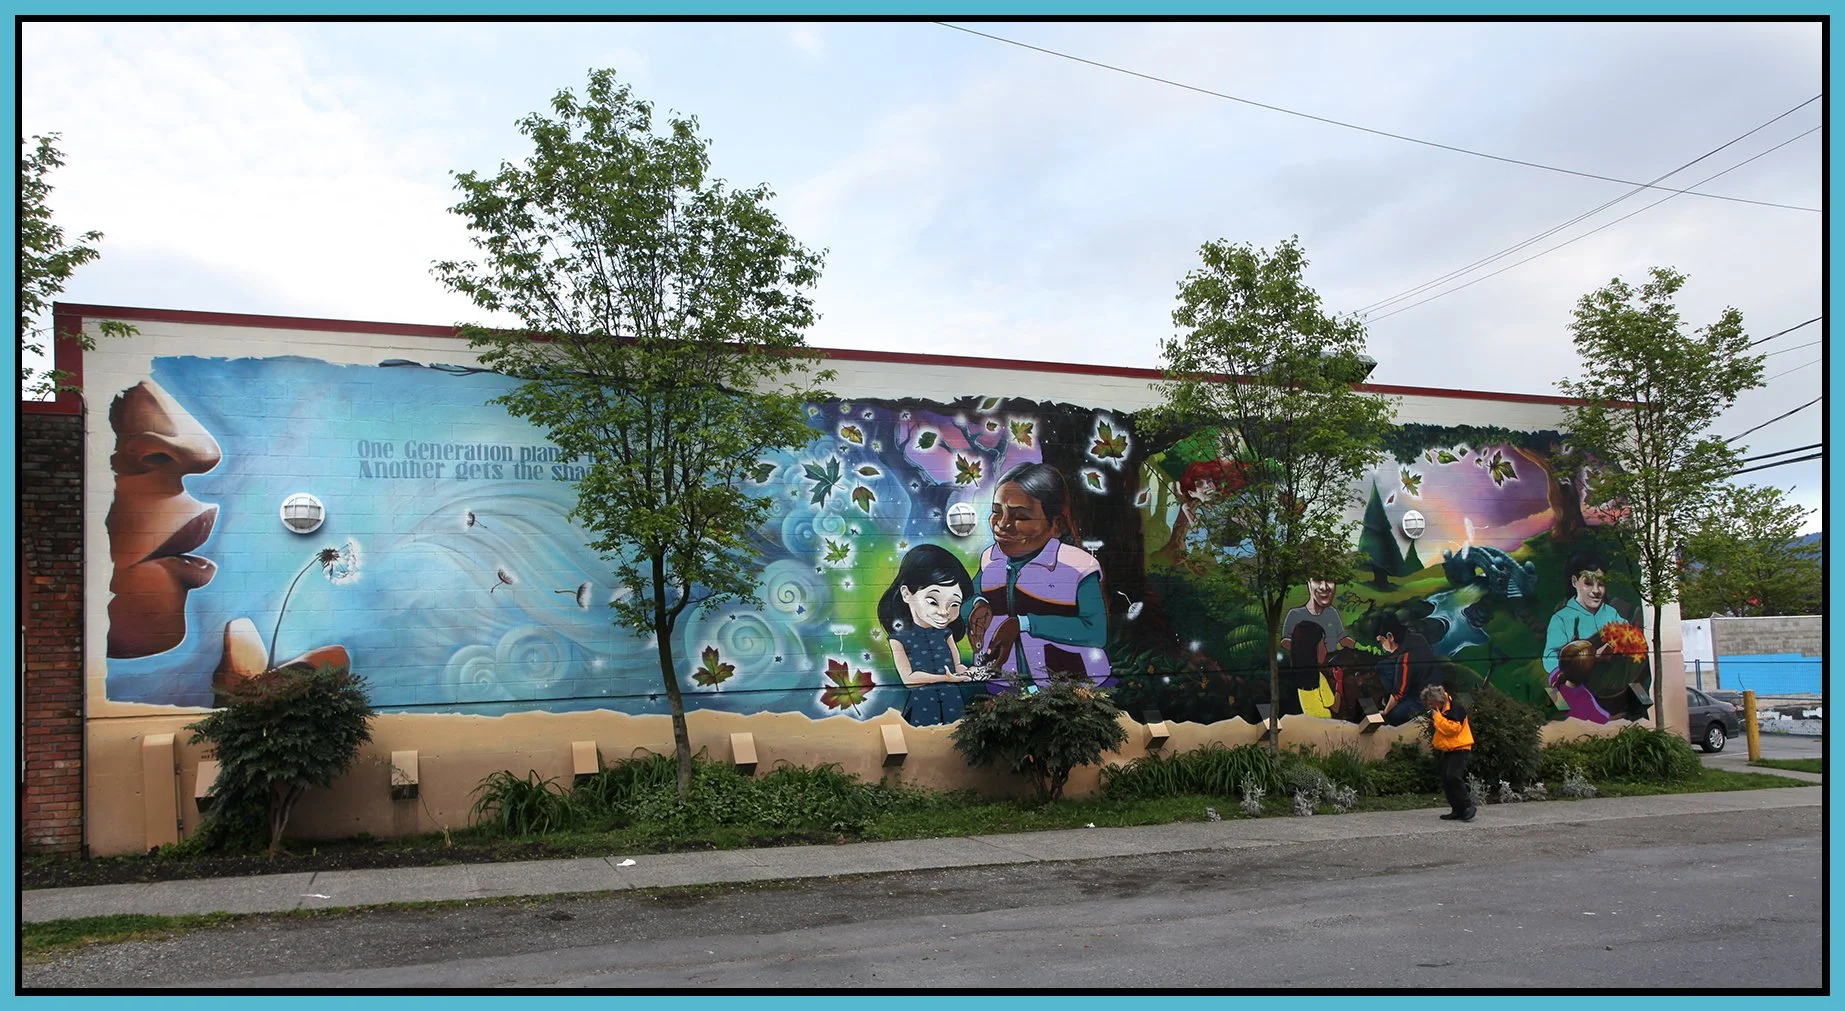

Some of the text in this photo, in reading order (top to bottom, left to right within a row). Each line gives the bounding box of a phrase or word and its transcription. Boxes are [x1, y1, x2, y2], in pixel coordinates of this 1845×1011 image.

[357, 440, 394, 459] One
[404, 440, 513, 462] Generation
[520, 446, 579, 463] plan
[359, 460, 446, 479] Another
[455, 461, 504, 481] gets
[513, 462, 544, 480] the
